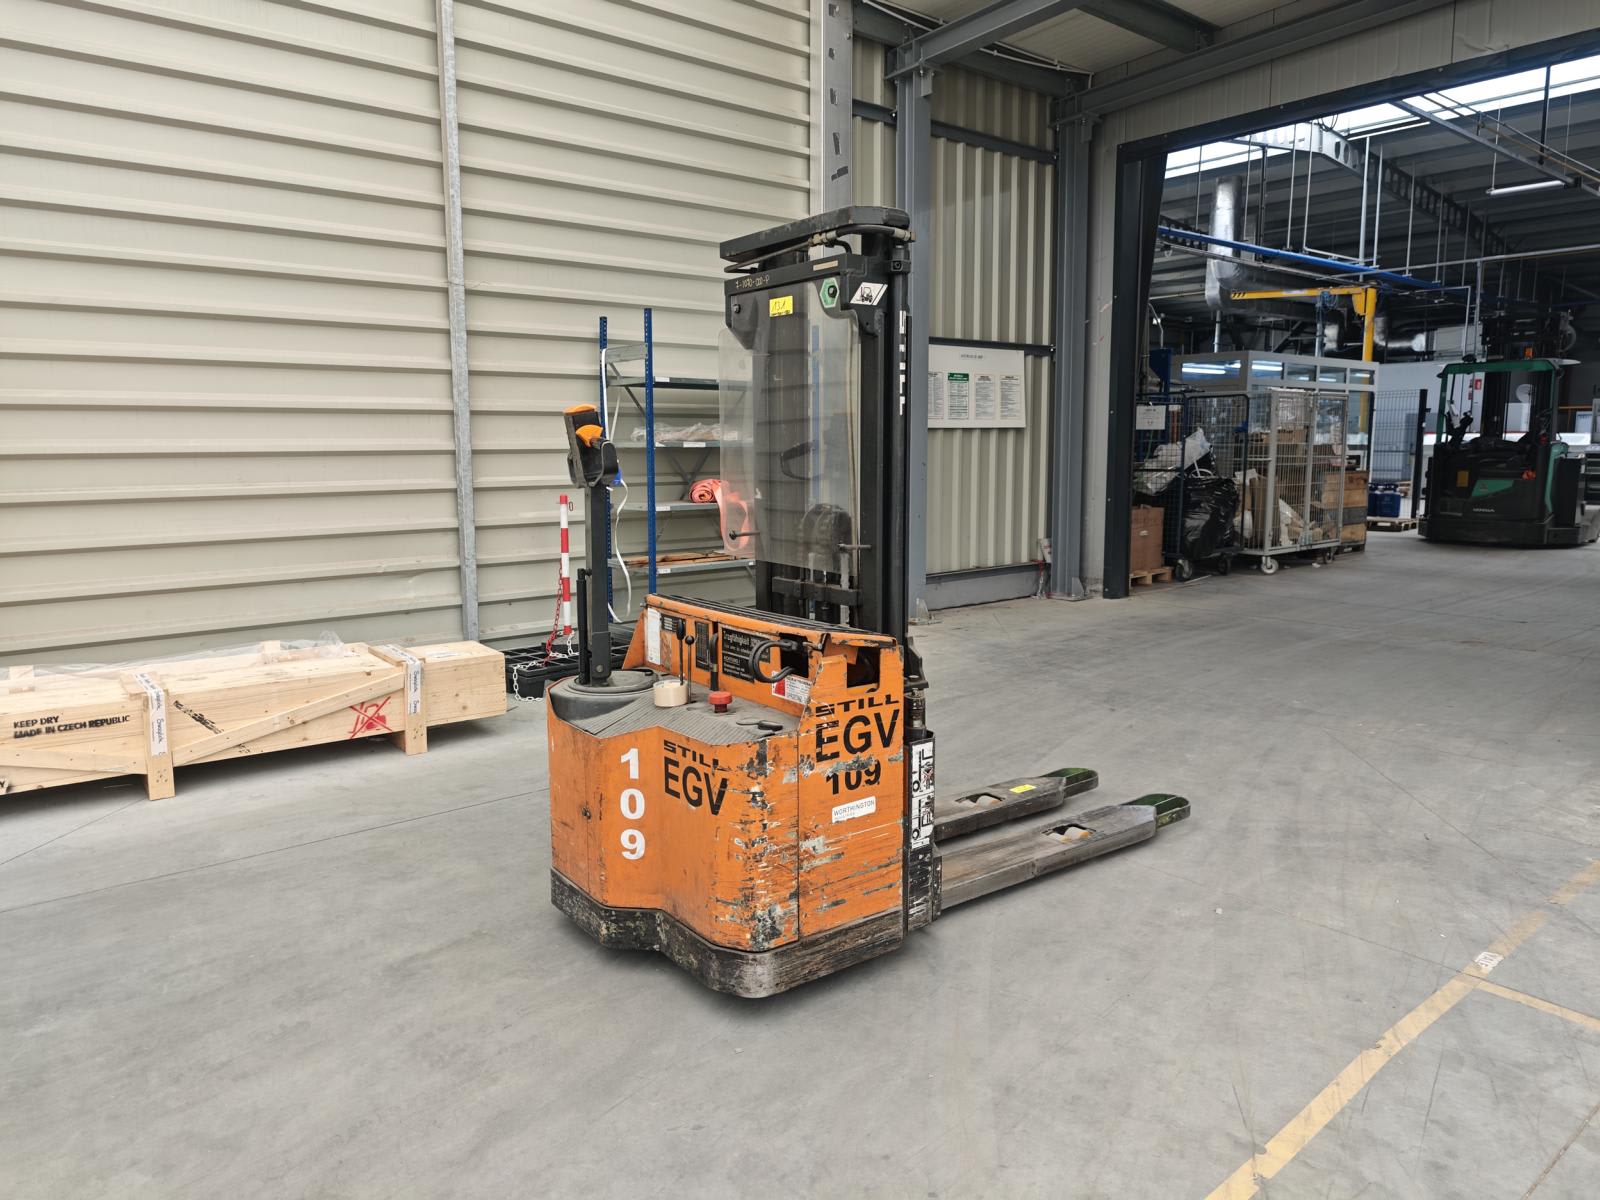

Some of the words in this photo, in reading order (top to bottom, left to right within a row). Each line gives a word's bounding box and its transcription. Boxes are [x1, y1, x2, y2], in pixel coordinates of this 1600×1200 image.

[13, 718, 38, 728] KEEP
[40, 715, 60, 725] DRY
[815, 694, 900, 717] STILL
[13, 727, 42, 739] MADE
[45, 725, 56, 734] IN
[57, 721, 87, 732] CZECH
[88, 715, 131, 728] REPUBLIC
[815, 709, 900, 763] EGV
[663, 739, 732, 772] STILL
[664, 756, 728, 816] EGV
[826, 759, 882, 796] 109
